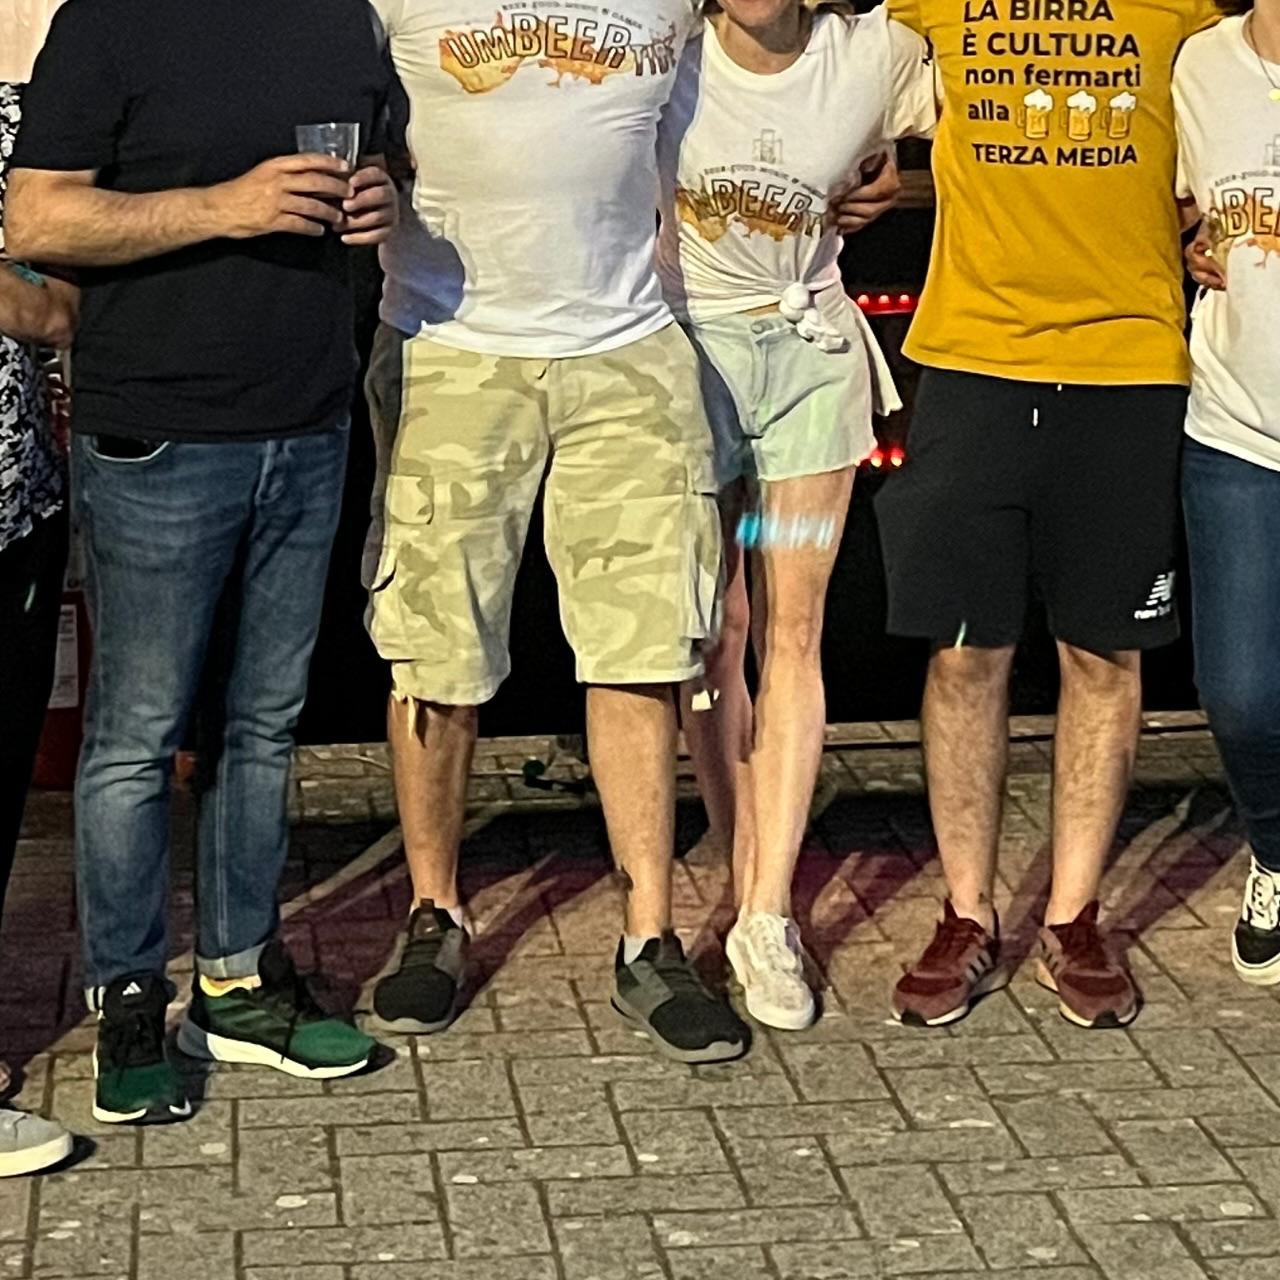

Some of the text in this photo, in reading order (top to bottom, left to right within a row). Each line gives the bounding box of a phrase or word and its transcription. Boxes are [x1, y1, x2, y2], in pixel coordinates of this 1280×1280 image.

[962, 27, 1140, 58] È CULTURA
[964, 63, 1141, 88] non fermarti
[967, 98, 1010, 122] alla
[971, 143, 1138, 167] TERZA MEDIA
